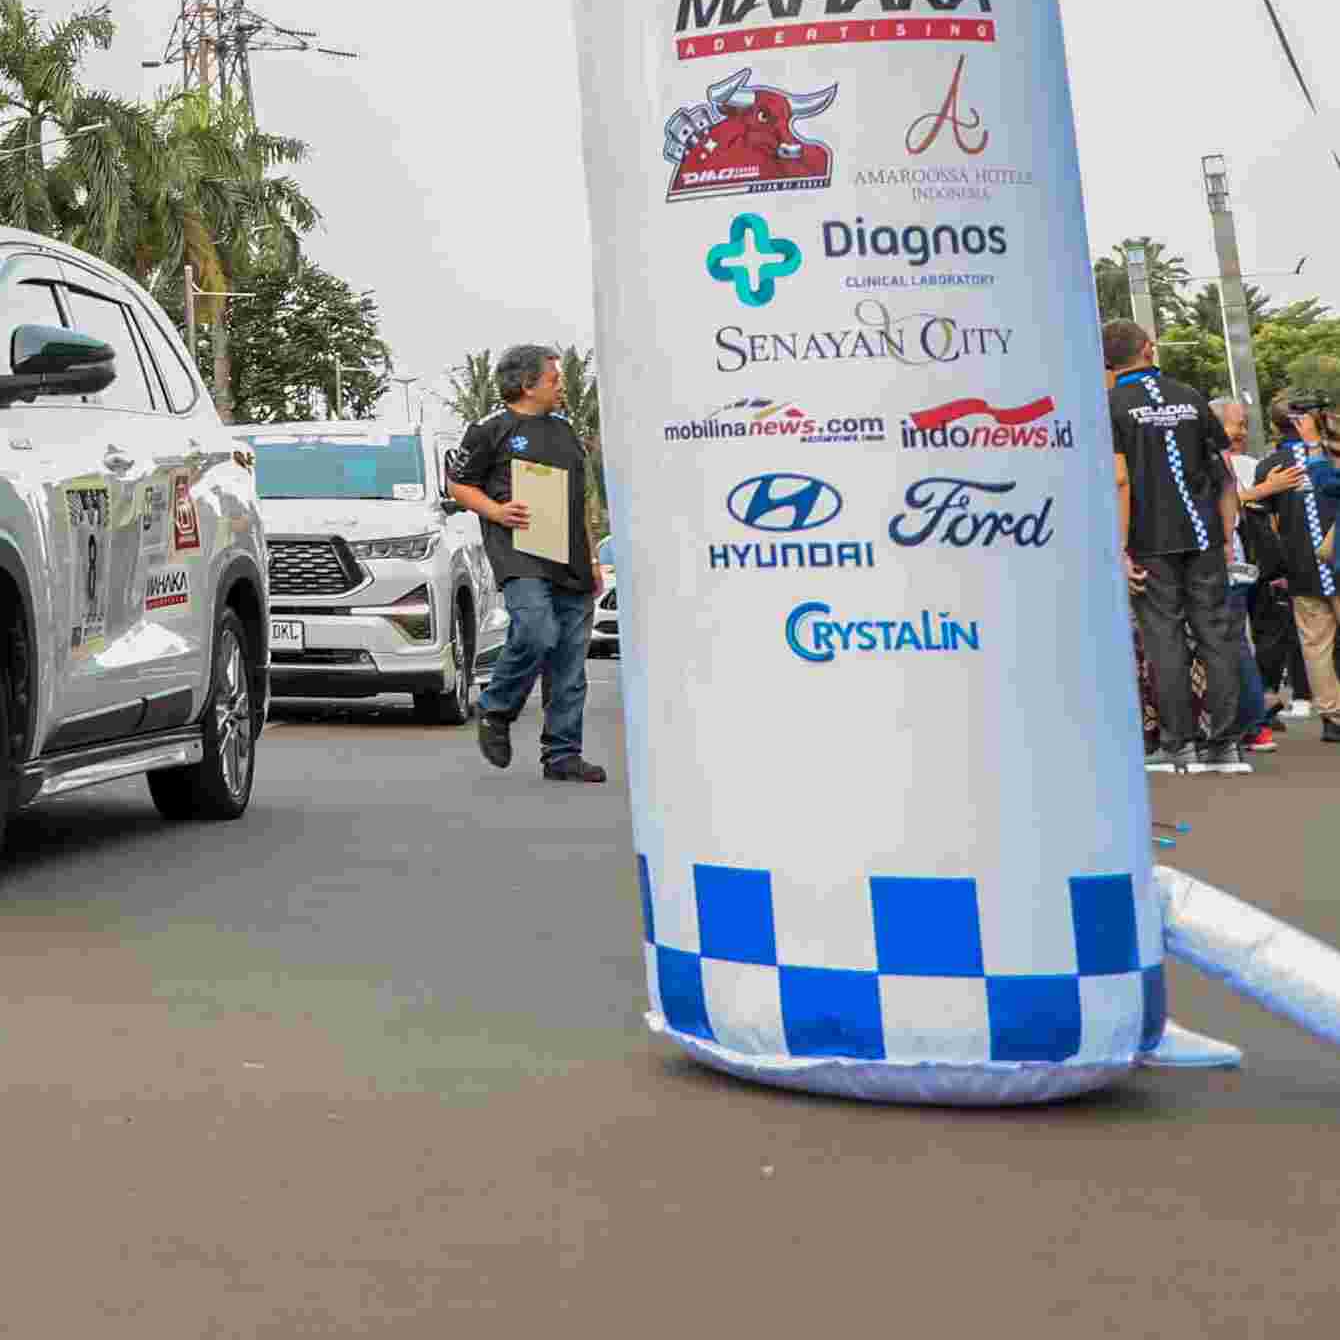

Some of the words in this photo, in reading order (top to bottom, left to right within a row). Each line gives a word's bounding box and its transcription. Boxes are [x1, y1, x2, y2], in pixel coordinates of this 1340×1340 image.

[685, 23, 987, 57] ADVERTISING
[823, 217, 1007, 265] Diagnos
[846, 275, 909, 288] CLINICAL
[913, 274, 994, 287] LABORATORY
[715, 325, 904, 372] SENAYAN
[920, 316, 1013, 362] CITY
[664, 416, 884, 441] mobilinanews.com
[901, 418, 1073, 449] indonews.id
[888, 476, 1055, 548] Ford
[709, 542, 874, 568] HYUNDAI
